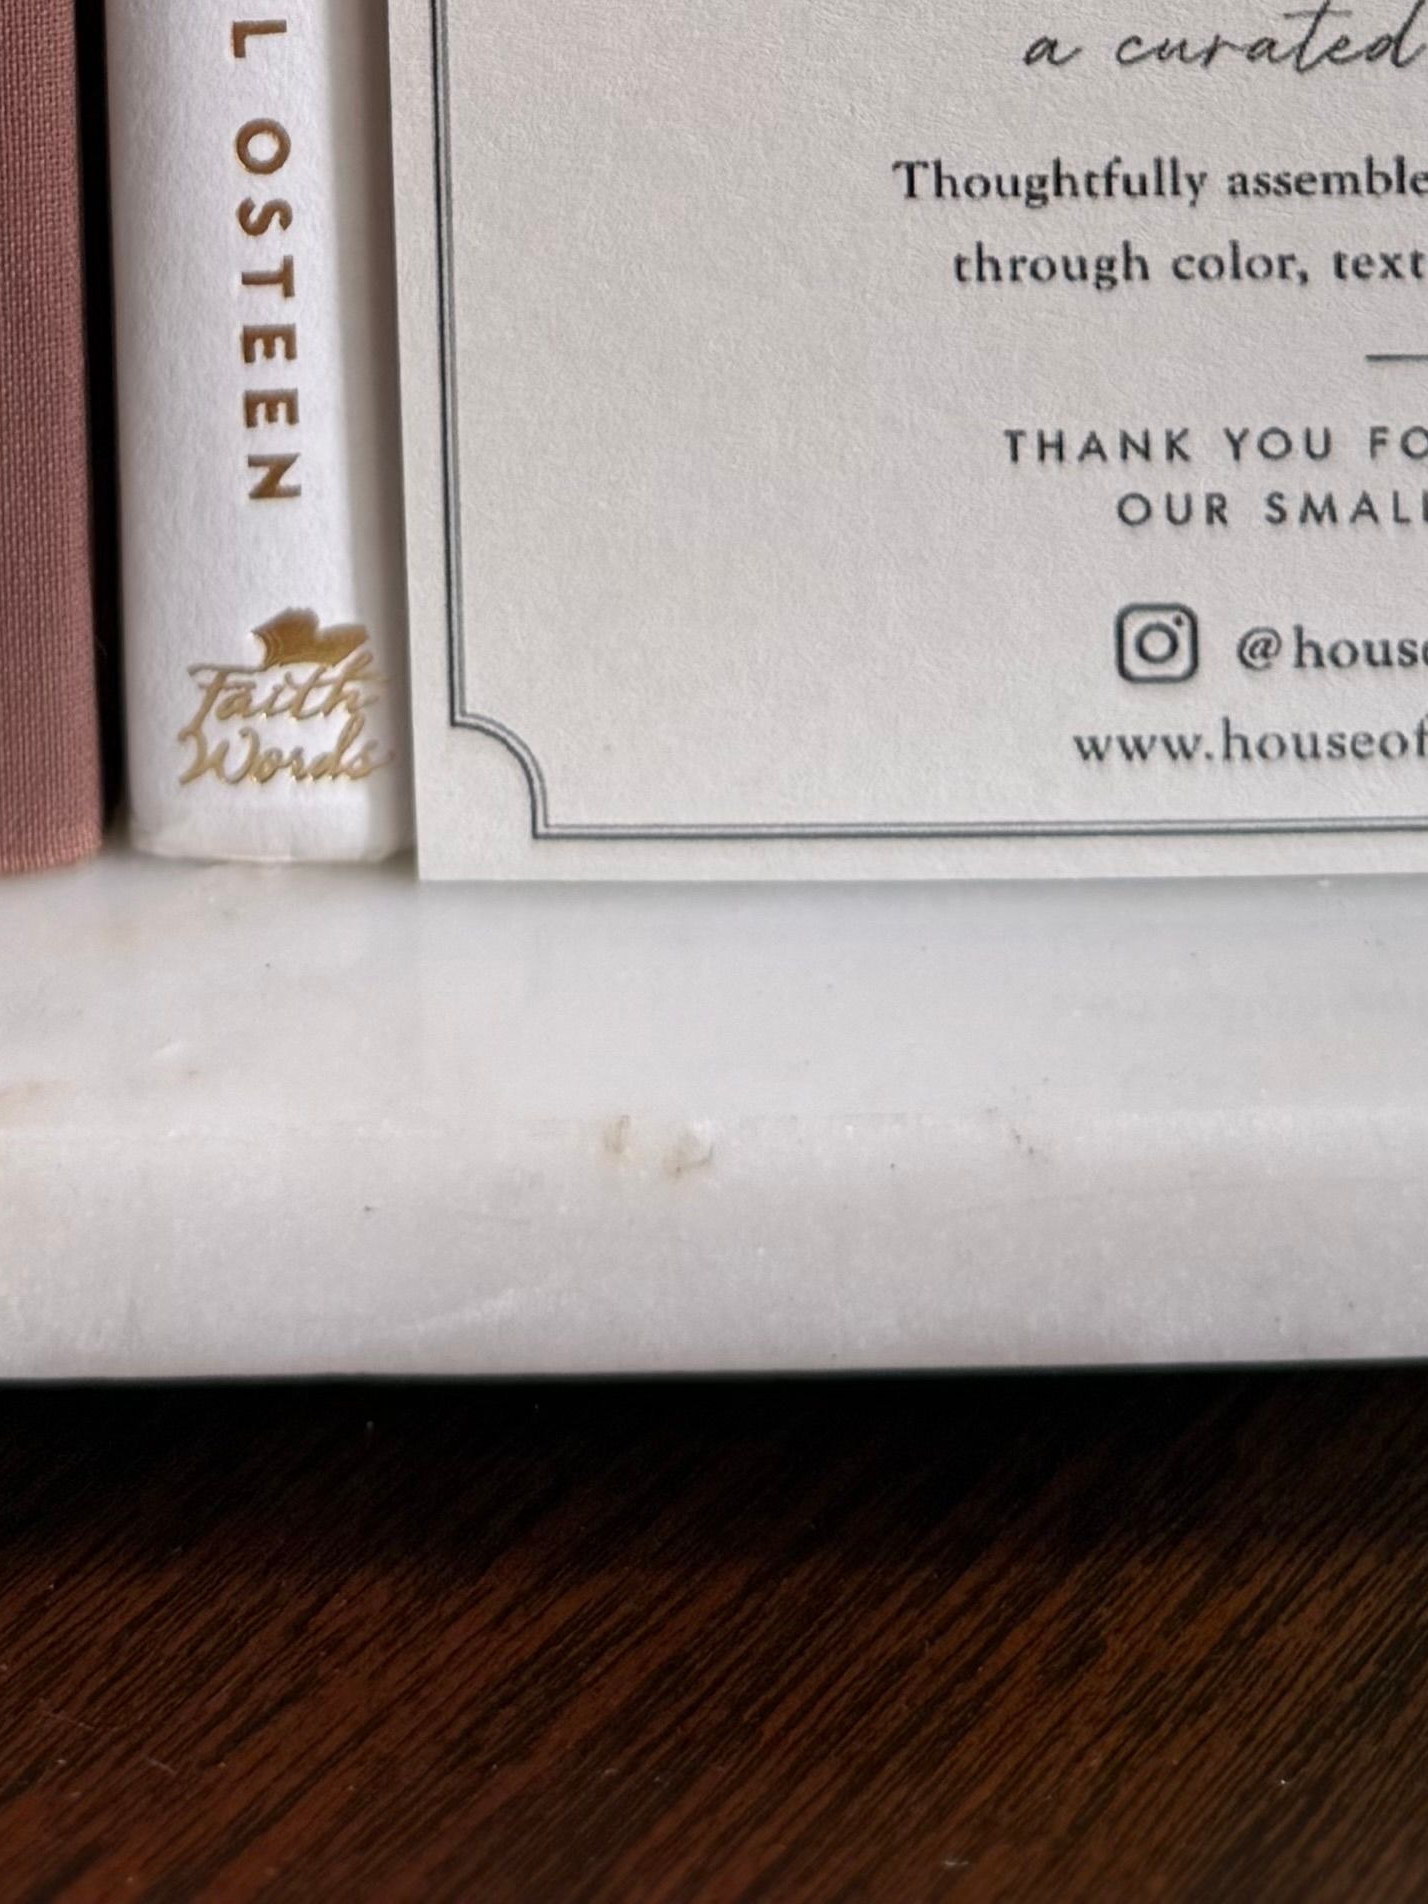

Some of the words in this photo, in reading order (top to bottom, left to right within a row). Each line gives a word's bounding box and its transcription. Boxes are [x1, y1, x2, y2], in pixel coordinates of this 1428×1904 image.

[1022, 32, 1083, 68] a
[891, 155, 1210, 209] Thoughtfully
[953, 239, 1151, 291] through
[1171, 238, 1312, 287] color,
[233, 116, 302, 502] OSTEEN
[1002, 428, 1194, 466] THANK
[1223, 428, 1336, 464] YOU
[1116, 491, 1232, 529] OUR
[185, 649, 384, 727] Faith
[177, 712, 396, 786] Words
